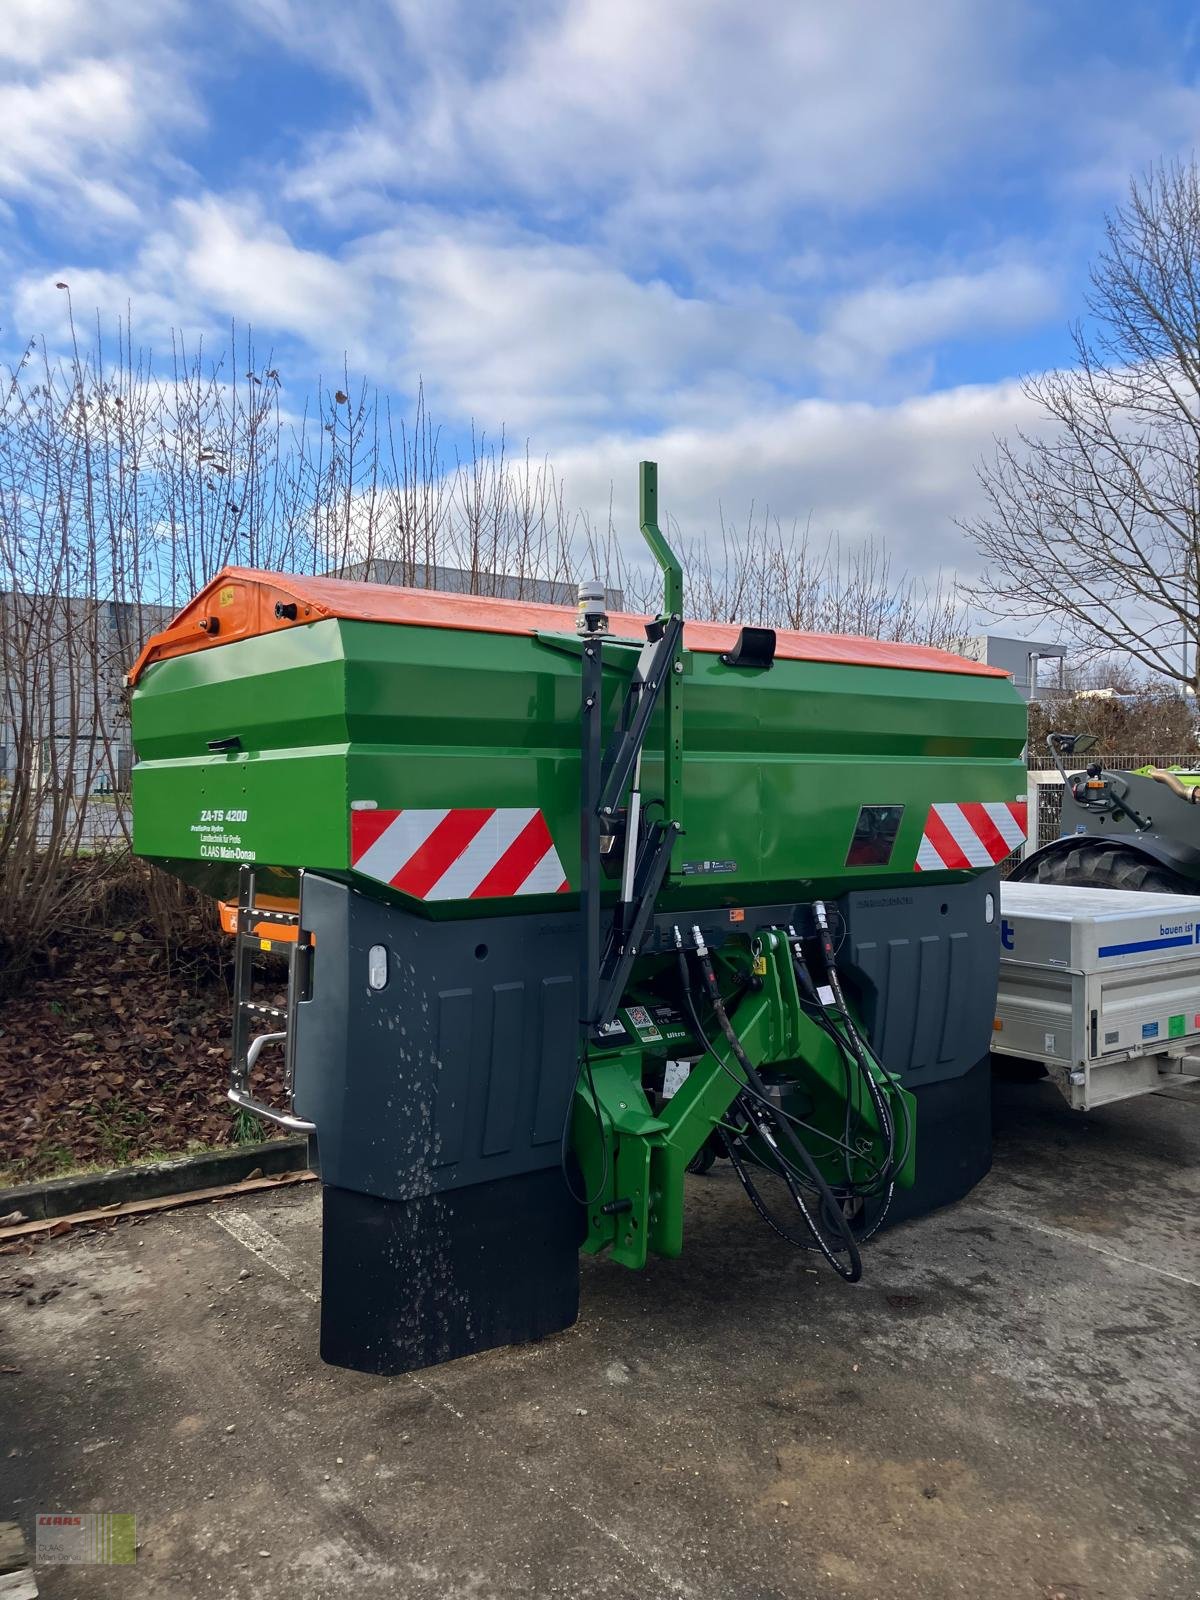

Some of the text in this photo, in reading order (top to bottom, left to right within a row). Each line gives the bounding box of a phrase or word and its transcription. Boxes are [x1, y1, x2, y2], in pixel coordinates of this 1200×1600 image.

[200, 810, 247, 821] ZA-TS 4200
[200, 833, 223, 843] Landtechnik
[229, 835, 241, 844] Profis
[200, 845, 256, 860] CLAAS Main-Donau
[1160, 924, 1183, 935] bauen
[1184, 922, 1193, 932] ist
